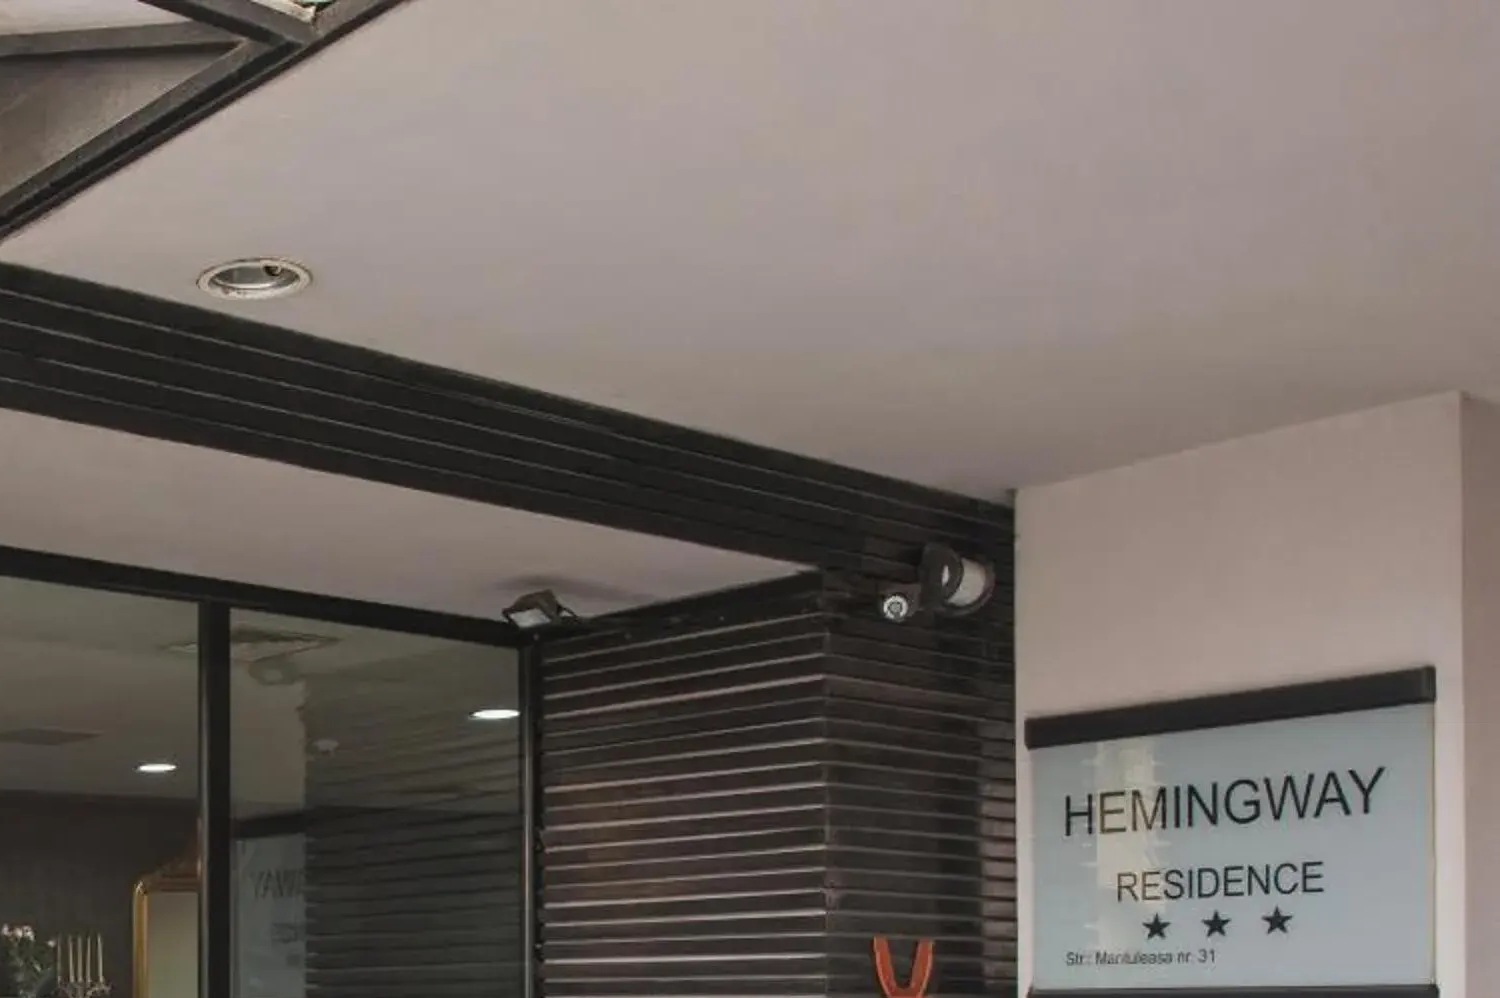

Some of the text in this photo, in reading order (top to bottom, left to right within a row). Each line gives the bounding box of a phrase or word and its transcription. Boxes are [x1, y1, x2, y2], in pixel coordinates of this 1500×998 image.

[1065, 766, 1386, 836] HEMINGWAY
[1117, 861, 1325, 902] RESIDENCE
[1198, 947, 1217, 963] 31
